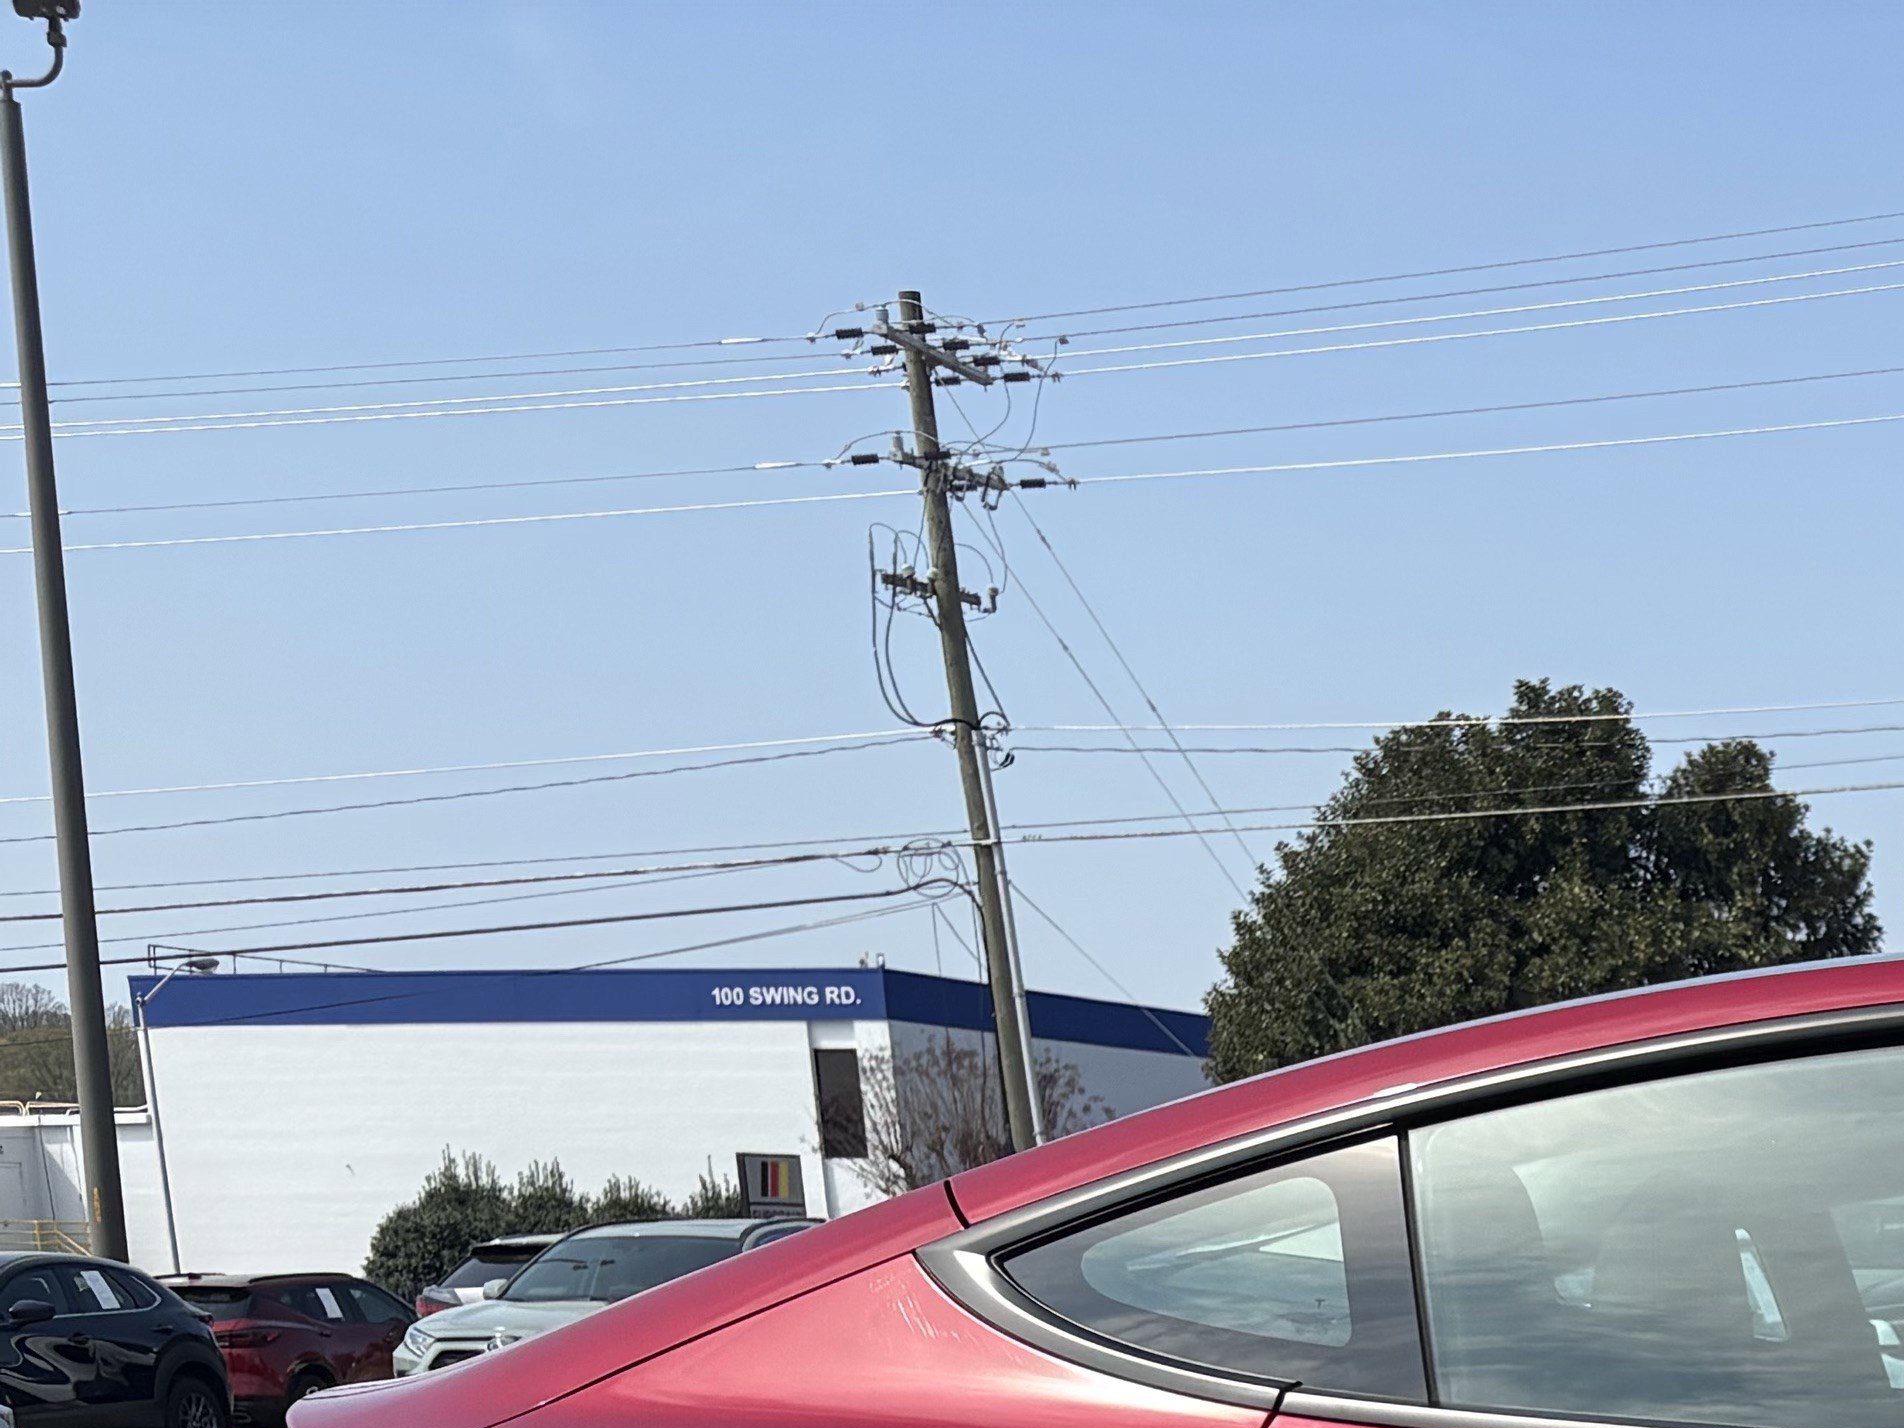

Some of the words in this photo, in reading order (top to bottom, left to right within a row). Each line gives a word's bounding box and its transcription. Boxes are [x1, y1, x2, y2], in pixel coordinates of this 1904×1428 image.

[711, 987, 744, 1005] 100
[749, 986, 819, 1005] SWING
[824, 986, 862, 1005] RD.
